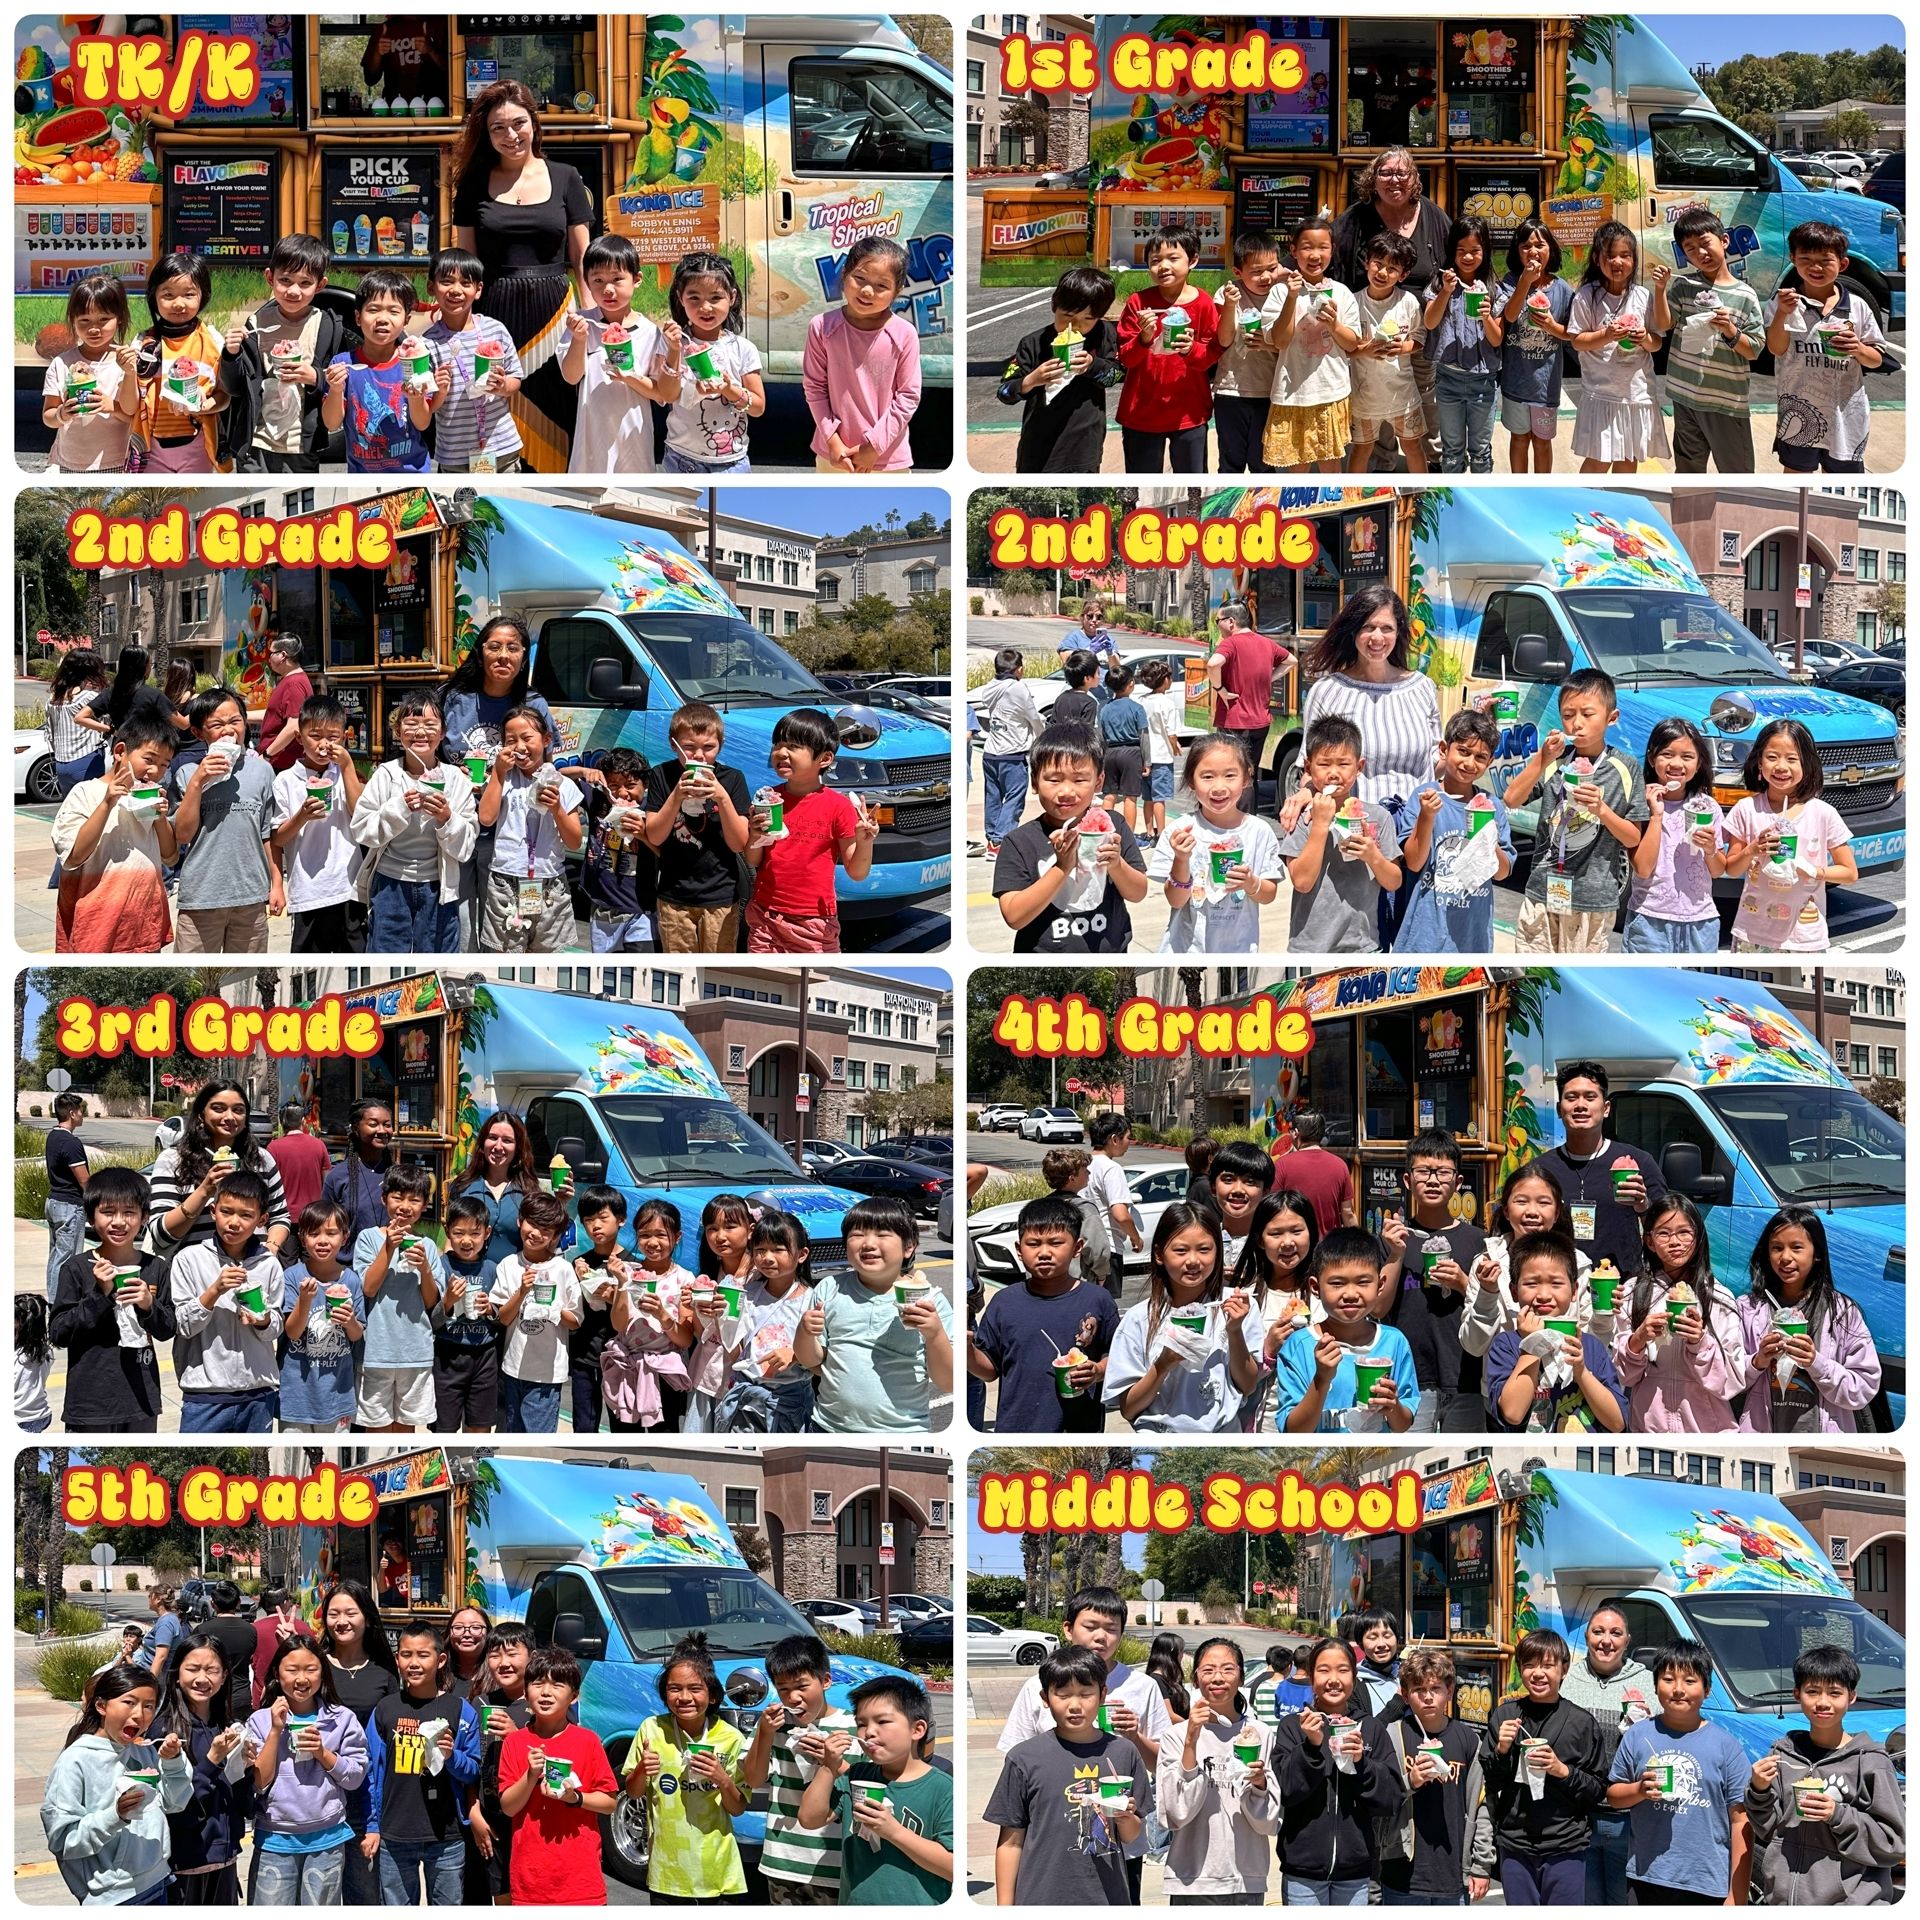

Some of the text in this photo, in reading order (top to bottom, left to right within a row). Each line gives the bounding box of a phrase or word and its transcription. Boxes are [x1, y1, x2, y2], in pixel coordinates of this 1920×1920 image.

[190, 105, 245, 113] OMMUNITY
[174, 159, 269, 185] FLAVORWAVE
[349, 157, 409, 177] PICK
[350, 175, 410, 185] YOUR CUP
[618, 188, 704, 216] KONA ICE
[1463, 192, 1533, 218] $200
[1549, 200, 1583, 214] KONA
[1583, 197, 1603, 209] ICE
[809, 190, 883, 230] Tropical
[630, 218, 702, 228] ROBBYN ENNIS
[832, 211, 902, 248] Shaved
[992, 210, 1088, 245] FLAVORWAVE
[641, 226, 694, 236] 714.415.8911
[630, 237, 650, 246] 2719
[651, 237, 689, 245] WESTERN
[652, 244, 680, 252] GROVE,
[692, 242, 716, 251] 92841
[175, 245, 261, 255] BE CREATIVE!
[1805, 355, 1820, 367] FLY
[1278, 486, 1344, 511] KONA ICE
[767, 540, 812, 557] DIAMOND STAR
[1351, 551, 1376, 560] SMOOTHIES
[387, 584, 416, 594] SMOOTHIES
[337, 690, 360, 701] PICK
[1444, 829, 1459, 838] CAMP
[1445, 896, 1471, 909] E-PLEX
[1051, 913, 1107, 939] BOO
[1334, 966, 1422, 1009] KONA ICE
[377, 988, 403, 1016] ICE
[884, 993, 933, 1011] DIAMOND STAR
[1428, 1049, 1460, 1060] SMOOTHIES
[1067, 1081, 1080, 1089] STOP
[1373, 1168, 1397, 1181] PICK
[446, 1324, 489, 1335] CHANGER
[316, 1360, 337, 1368] E-PLEX
[387, 1463, 412, 1494] ICE
[1424, 1479, 1453, 1513] ICE
[1457, 1559, 1480, 1568] SMOOTHIES
[1457, 1684, 1492, 1713] $200
[680, 1779, 721, 1793] Spoti
[1678, 1790, 1712, 1809] Vibes
[1662, 1803, 1688, 1815] E-PLEX
